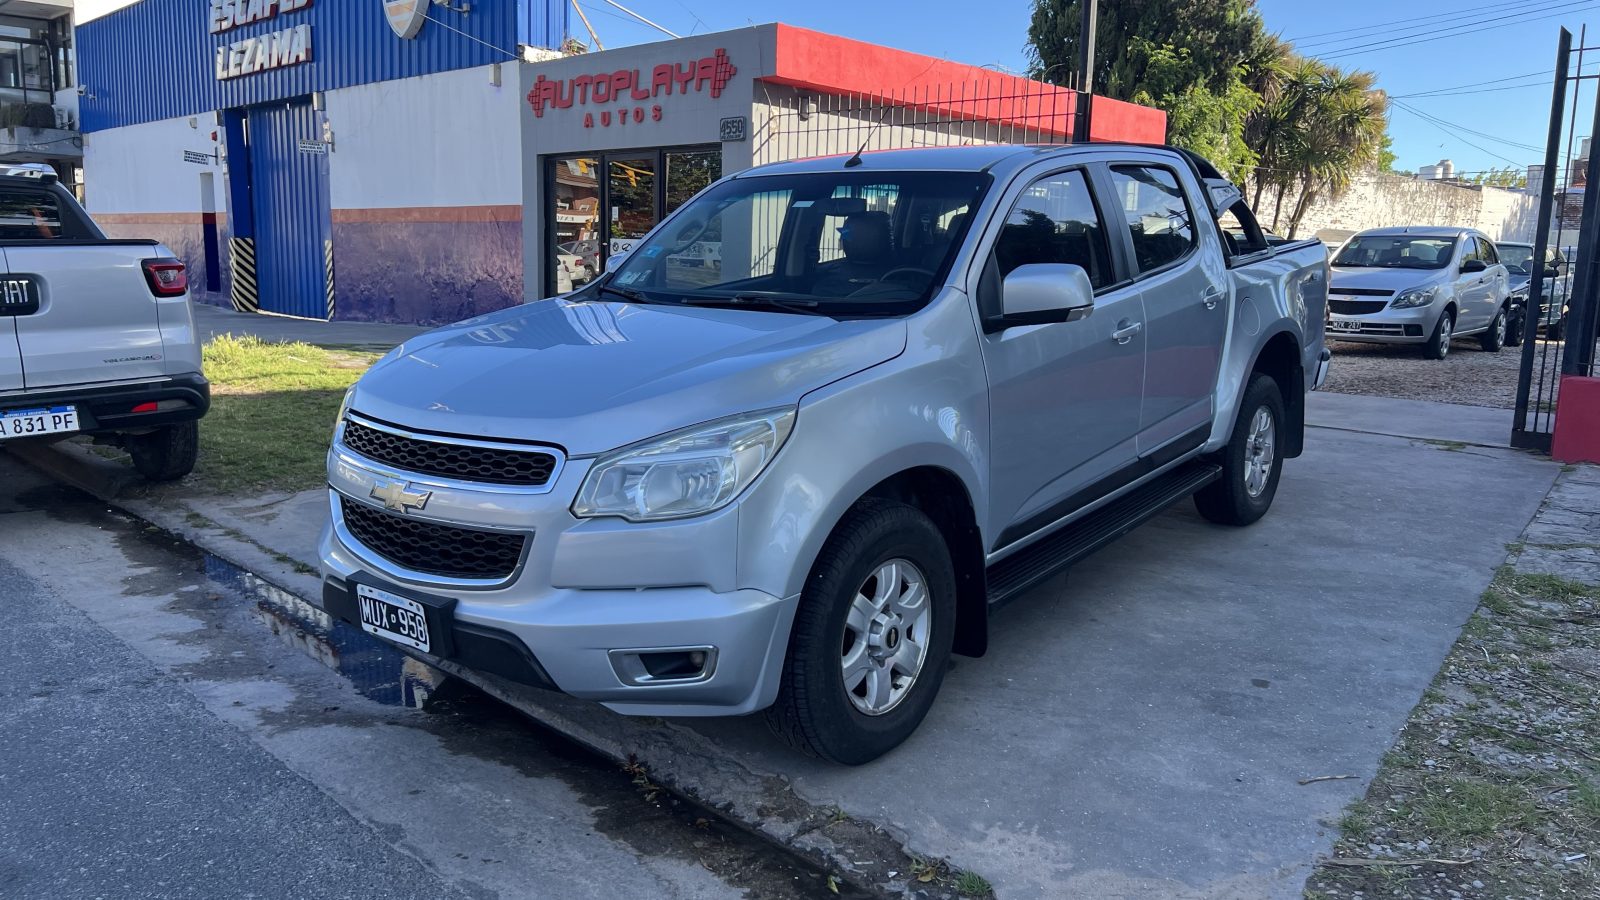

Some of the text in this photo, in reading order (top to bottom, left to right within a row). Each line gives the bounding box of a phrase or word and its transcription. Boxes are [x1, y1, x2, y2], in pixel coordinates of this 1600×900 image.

[216, 23, 310, 80] LEZAMA
[541, 57, 717, 109] AUTOPLAYA
[584, 104, 663, 128] AUTOS
[720, 119, 742, 134] 4550
[0, 280, 29, 304] IAT
[13, 416, 47, 434] 831
[52, 413, 73, 430] PF
[361, 597, 389, 629] MUX
[397, 608, 426, 642] 958
